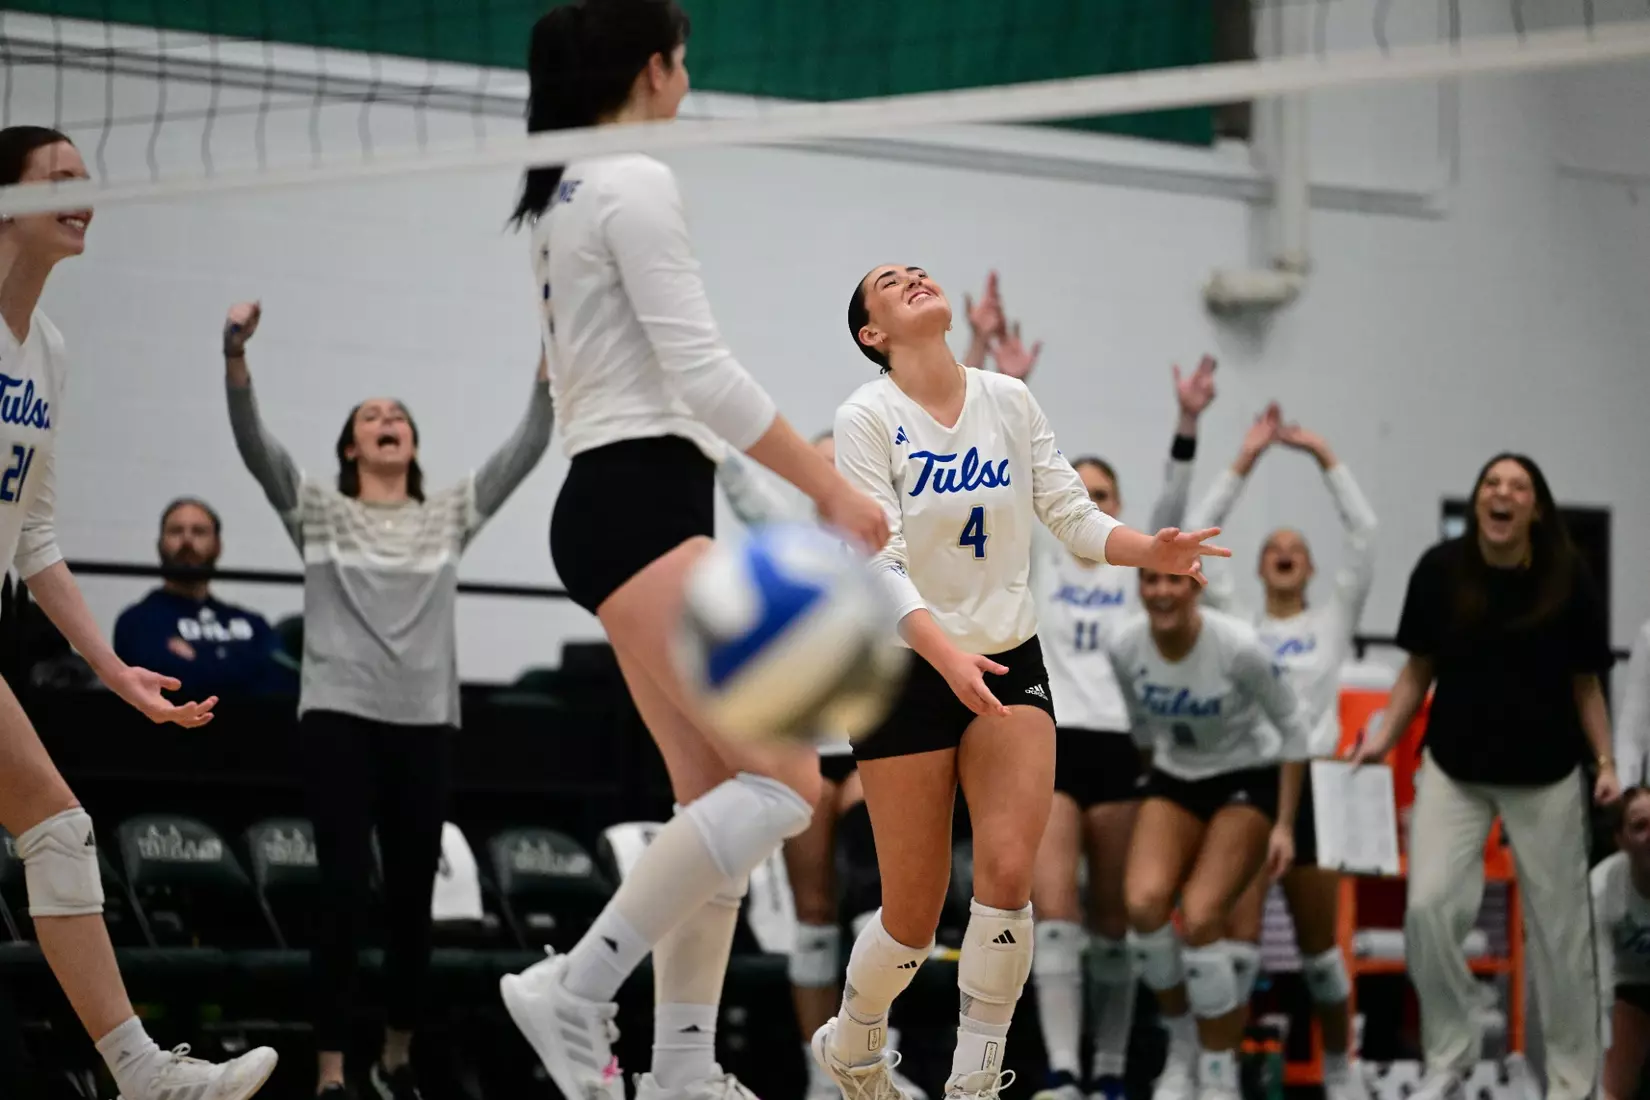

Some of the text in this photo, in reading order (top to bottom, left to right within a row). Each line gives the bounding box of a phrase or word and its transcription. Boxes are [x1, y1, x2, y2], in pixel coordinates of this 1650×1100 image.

[0, 373, 50, 430] Tuls
[0, 444, 35, 503] 21
[957, 503, 991, 560] 4
[1074, 620, 1099, 650] 11
